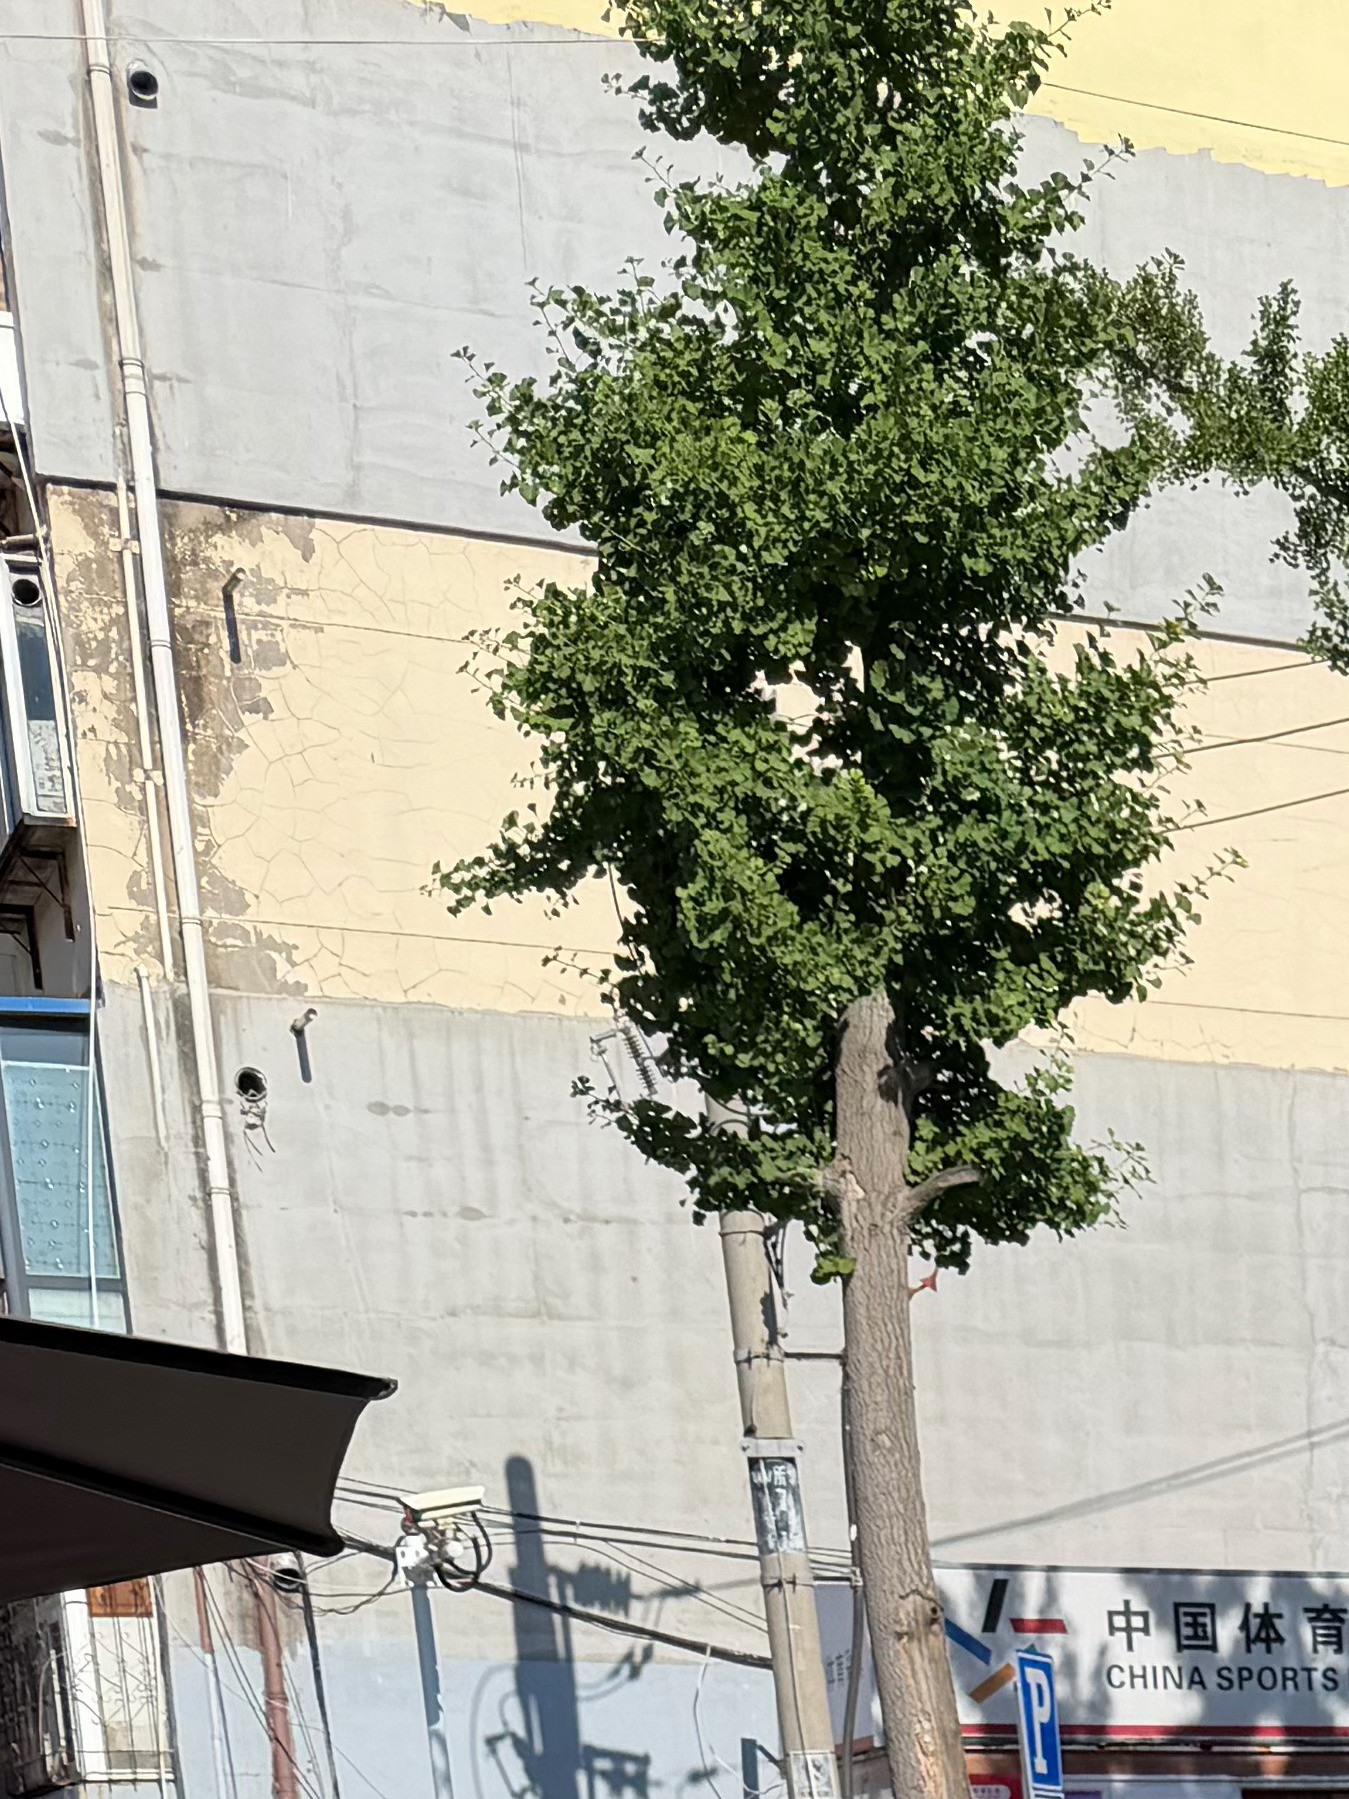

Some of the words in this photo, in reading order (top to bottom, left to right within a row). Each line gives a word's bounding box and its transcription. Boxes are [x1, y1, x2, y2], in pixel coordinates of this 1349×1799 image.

[1107, 1664, 1206, 1691] CHINA
[1216, 1667, 1340, 1692] SPORTS
[1024, 1666, 1052, 1775] P
